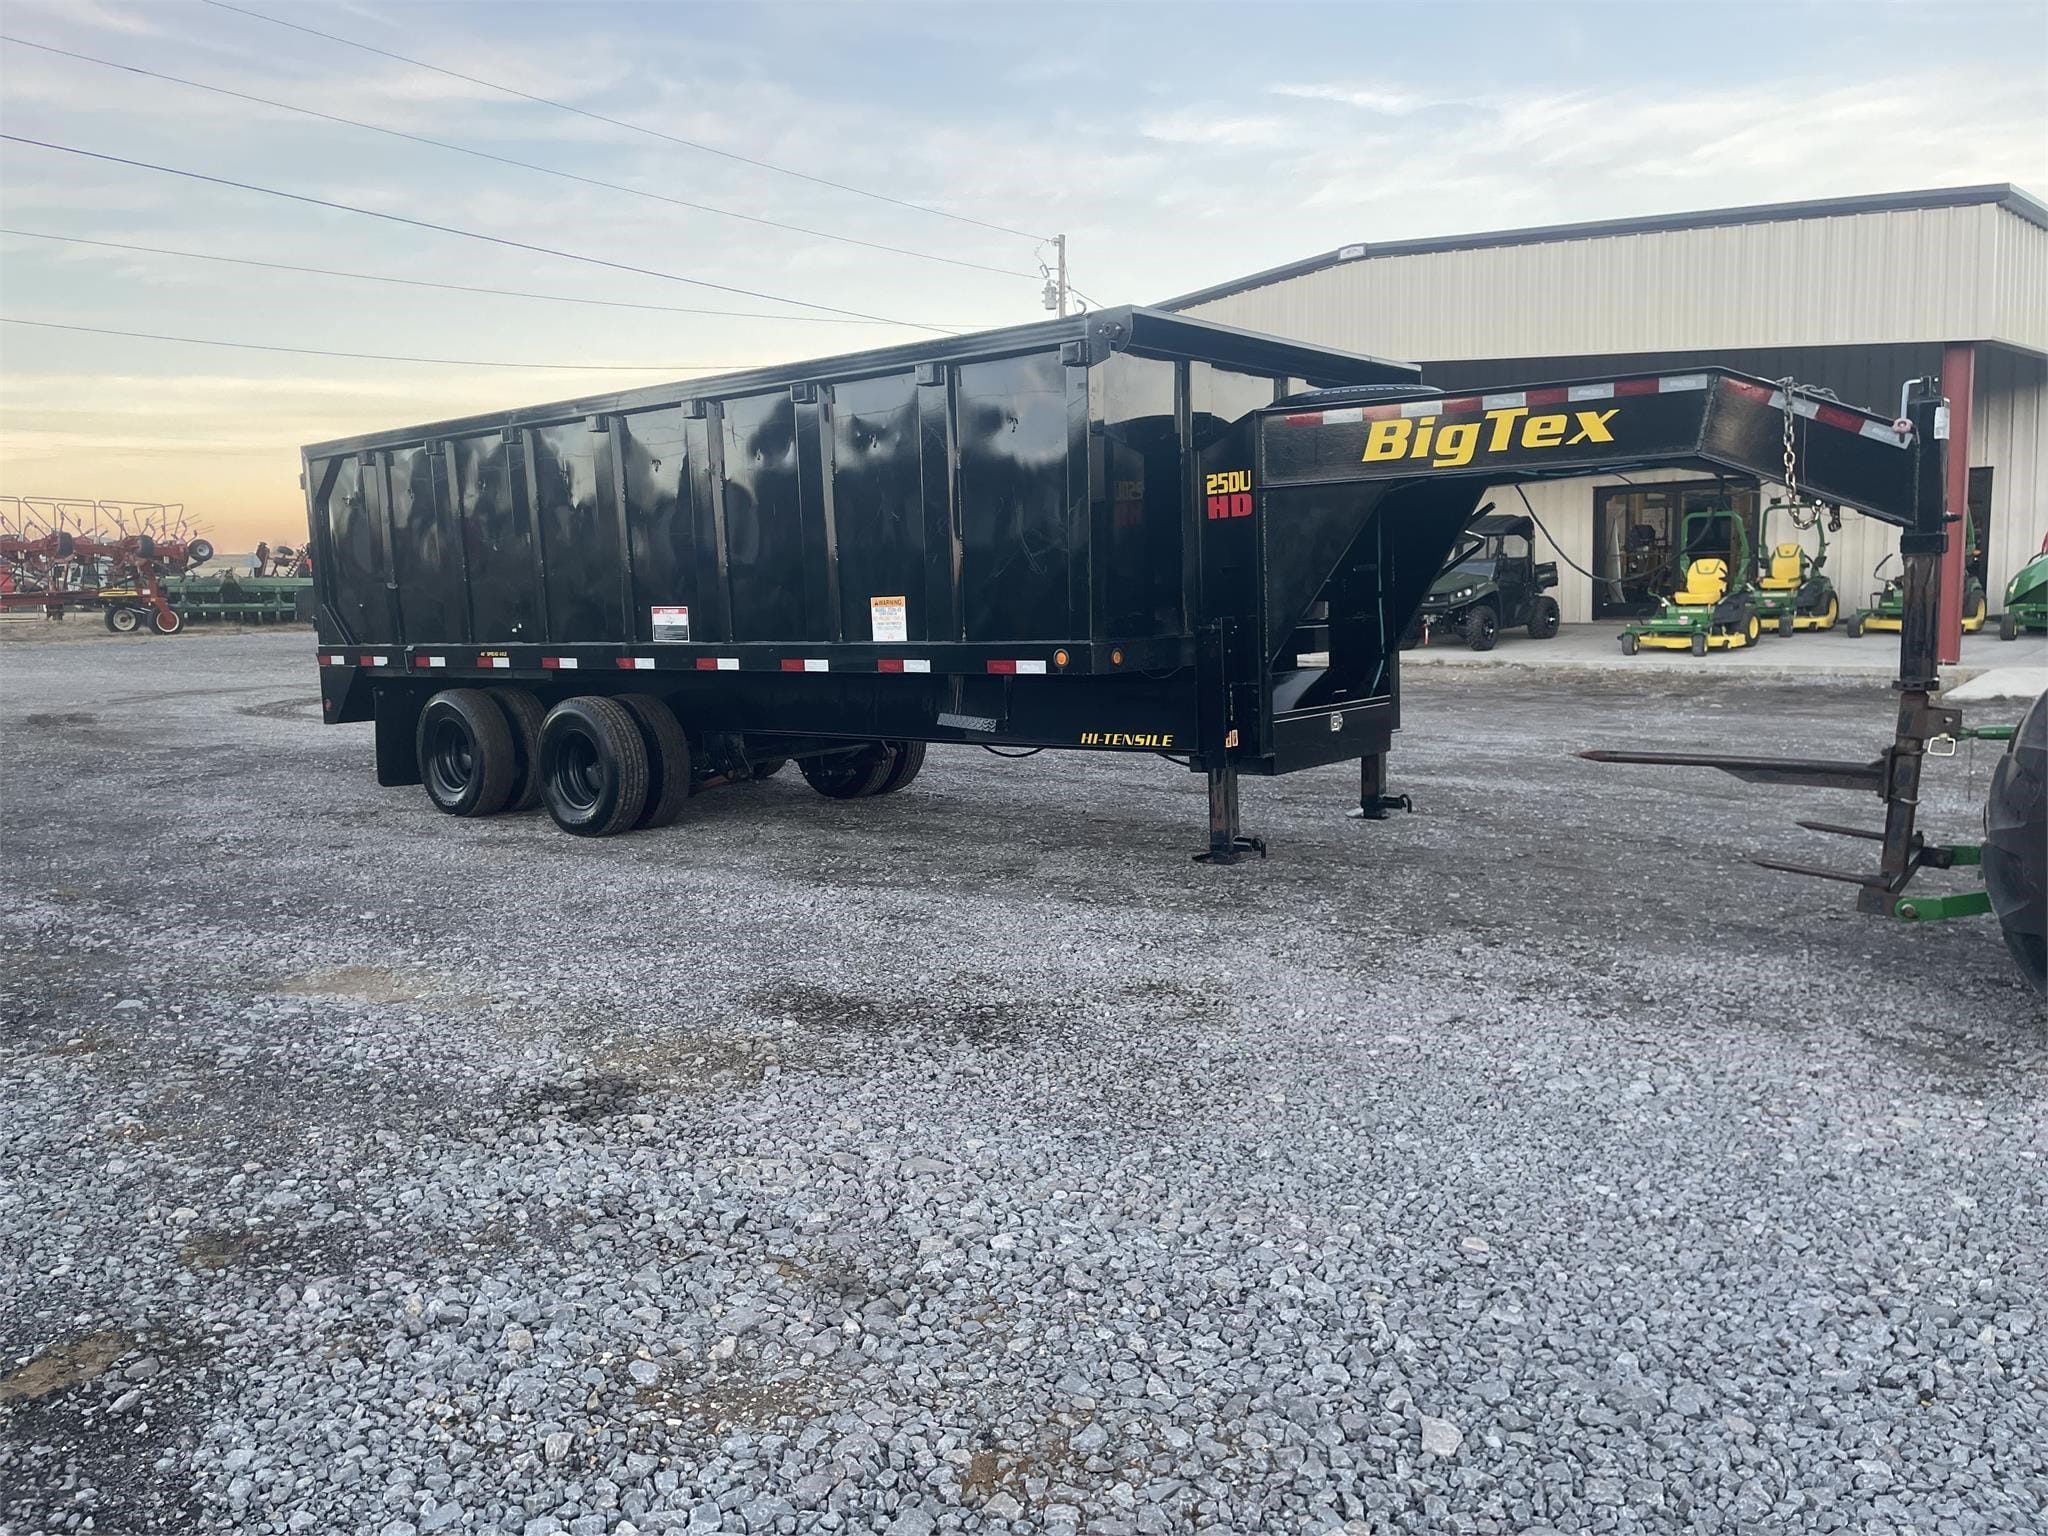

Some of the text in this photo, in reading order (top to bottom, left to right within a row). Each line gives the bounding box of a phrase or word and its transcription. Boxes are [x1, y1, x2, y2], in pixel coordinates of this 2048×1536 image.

[1361, 408, 1620, 467] BigTex
[1206, 470, 1251, 495] 25DU
[1207, 493, 1252, 519] HD
[879, 598, 902, 606] WARNING
[1080, 732, 1174, 747] HI-TENSILE
